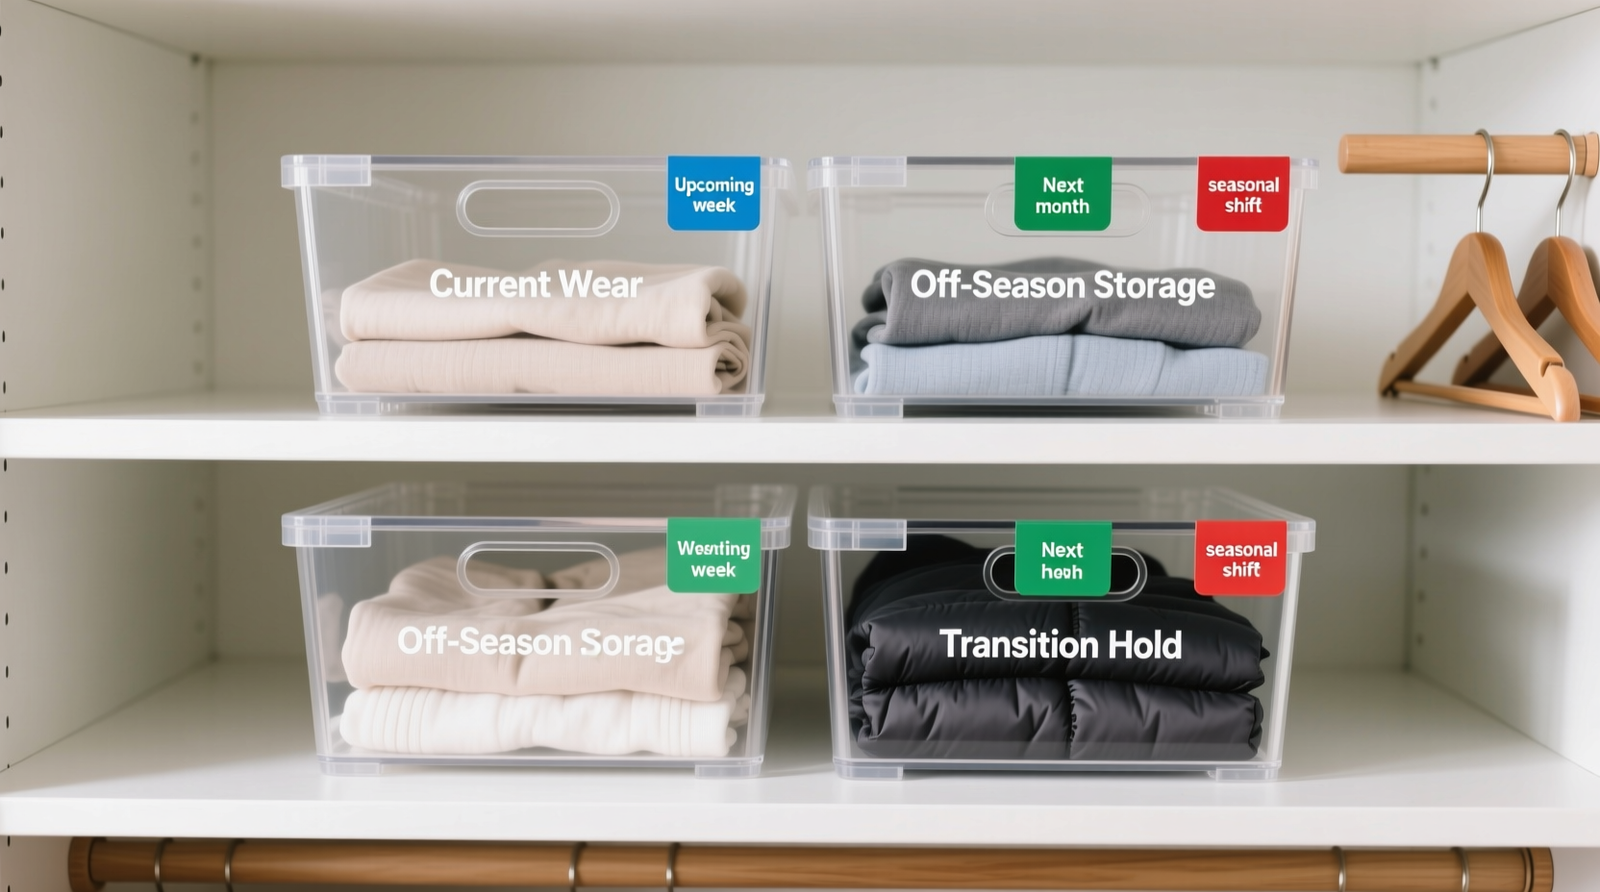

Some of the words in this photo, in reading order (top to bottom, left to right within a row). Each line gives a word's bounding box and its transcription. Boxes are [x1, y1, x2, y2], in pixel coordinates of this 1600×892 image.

[675, 176, 755, 197] Upcoming
[1043, 177, 1084, 193] Next
[1208, 177, 1280, 193] seasonal
[692, 197, 736, 213] week
[1035, 198, 1090, 214] month
[1225, 196, 1262, 213] shift
[429, 268, 551, 299] Current
[559, 269, 643, 299] Wear
[911, 269, 1085, 300] Off-Season
[1094, 270, 1216, 306] Storage
[1042, 541, 1084, 558] Next
[1206, 541, 1278, 557] seasonal
[690, 561, 736, 578] week
[1222, 561, 1261, 578] shift
[397, 625, 572, 656] Off-Season
[939, 628, 1099, 659] Transition
[1109, 629, 1182, 659] Hold
